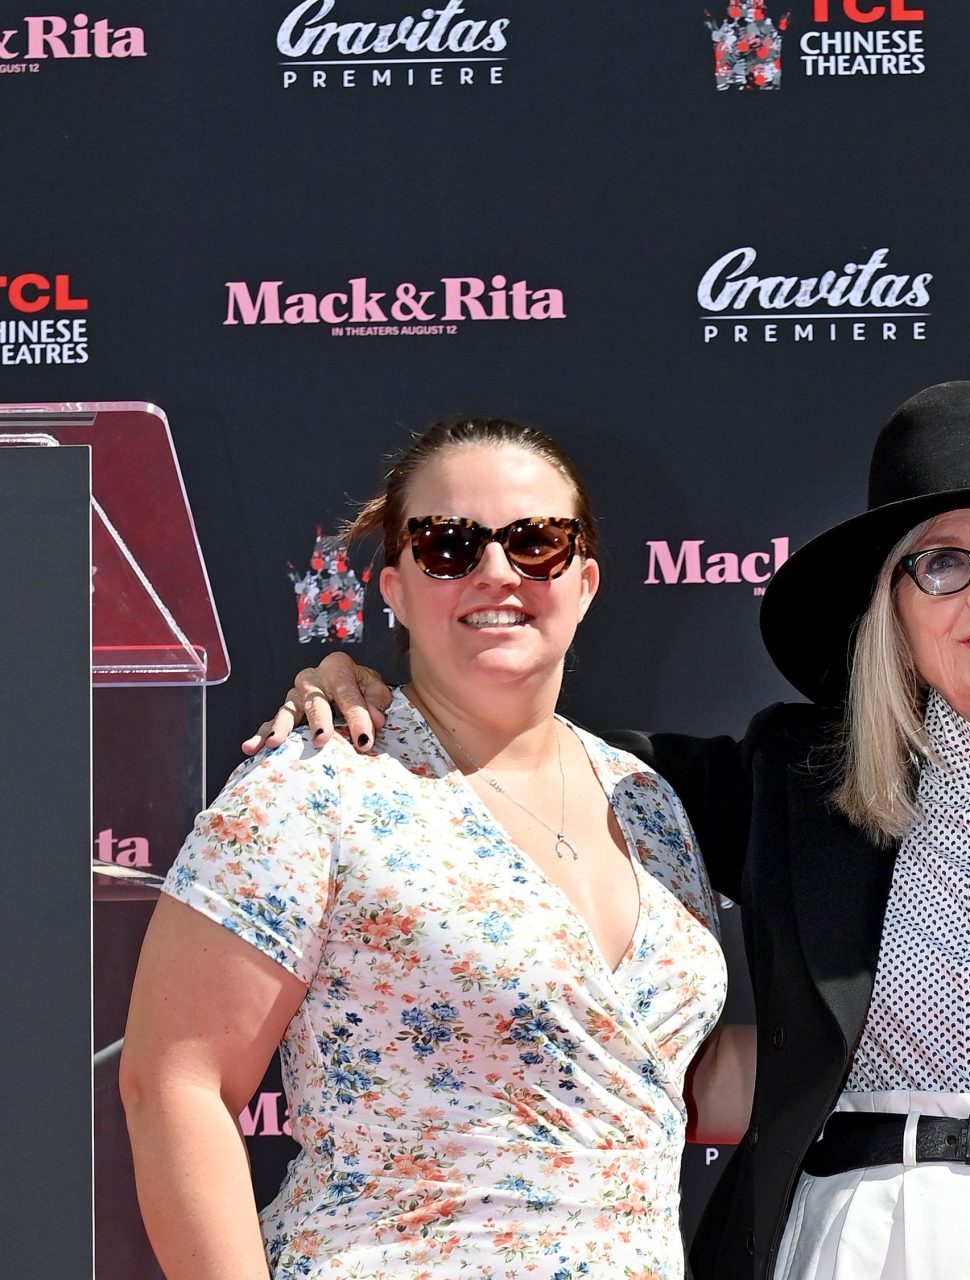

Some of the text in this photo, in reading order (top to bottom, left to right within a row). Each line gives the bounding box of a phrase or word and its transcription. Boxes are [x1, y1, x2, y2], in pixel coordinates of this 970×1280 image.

[277, 0, 510, 57] Gravitas
[800, 30, 924, 54] CHINESE
[29, 63, 40, 73] 12
[800, 54, 925, 76] THEATRES
[284, 67, 503, 88] PREMIERE
[697, 247, 933, 311] Gravitas
[0, 273, 88, 312] CL
[331, 325, 457, 336] IN THEATERS AUGUST 12
[705, 322, 926, 342] PREMIERE
